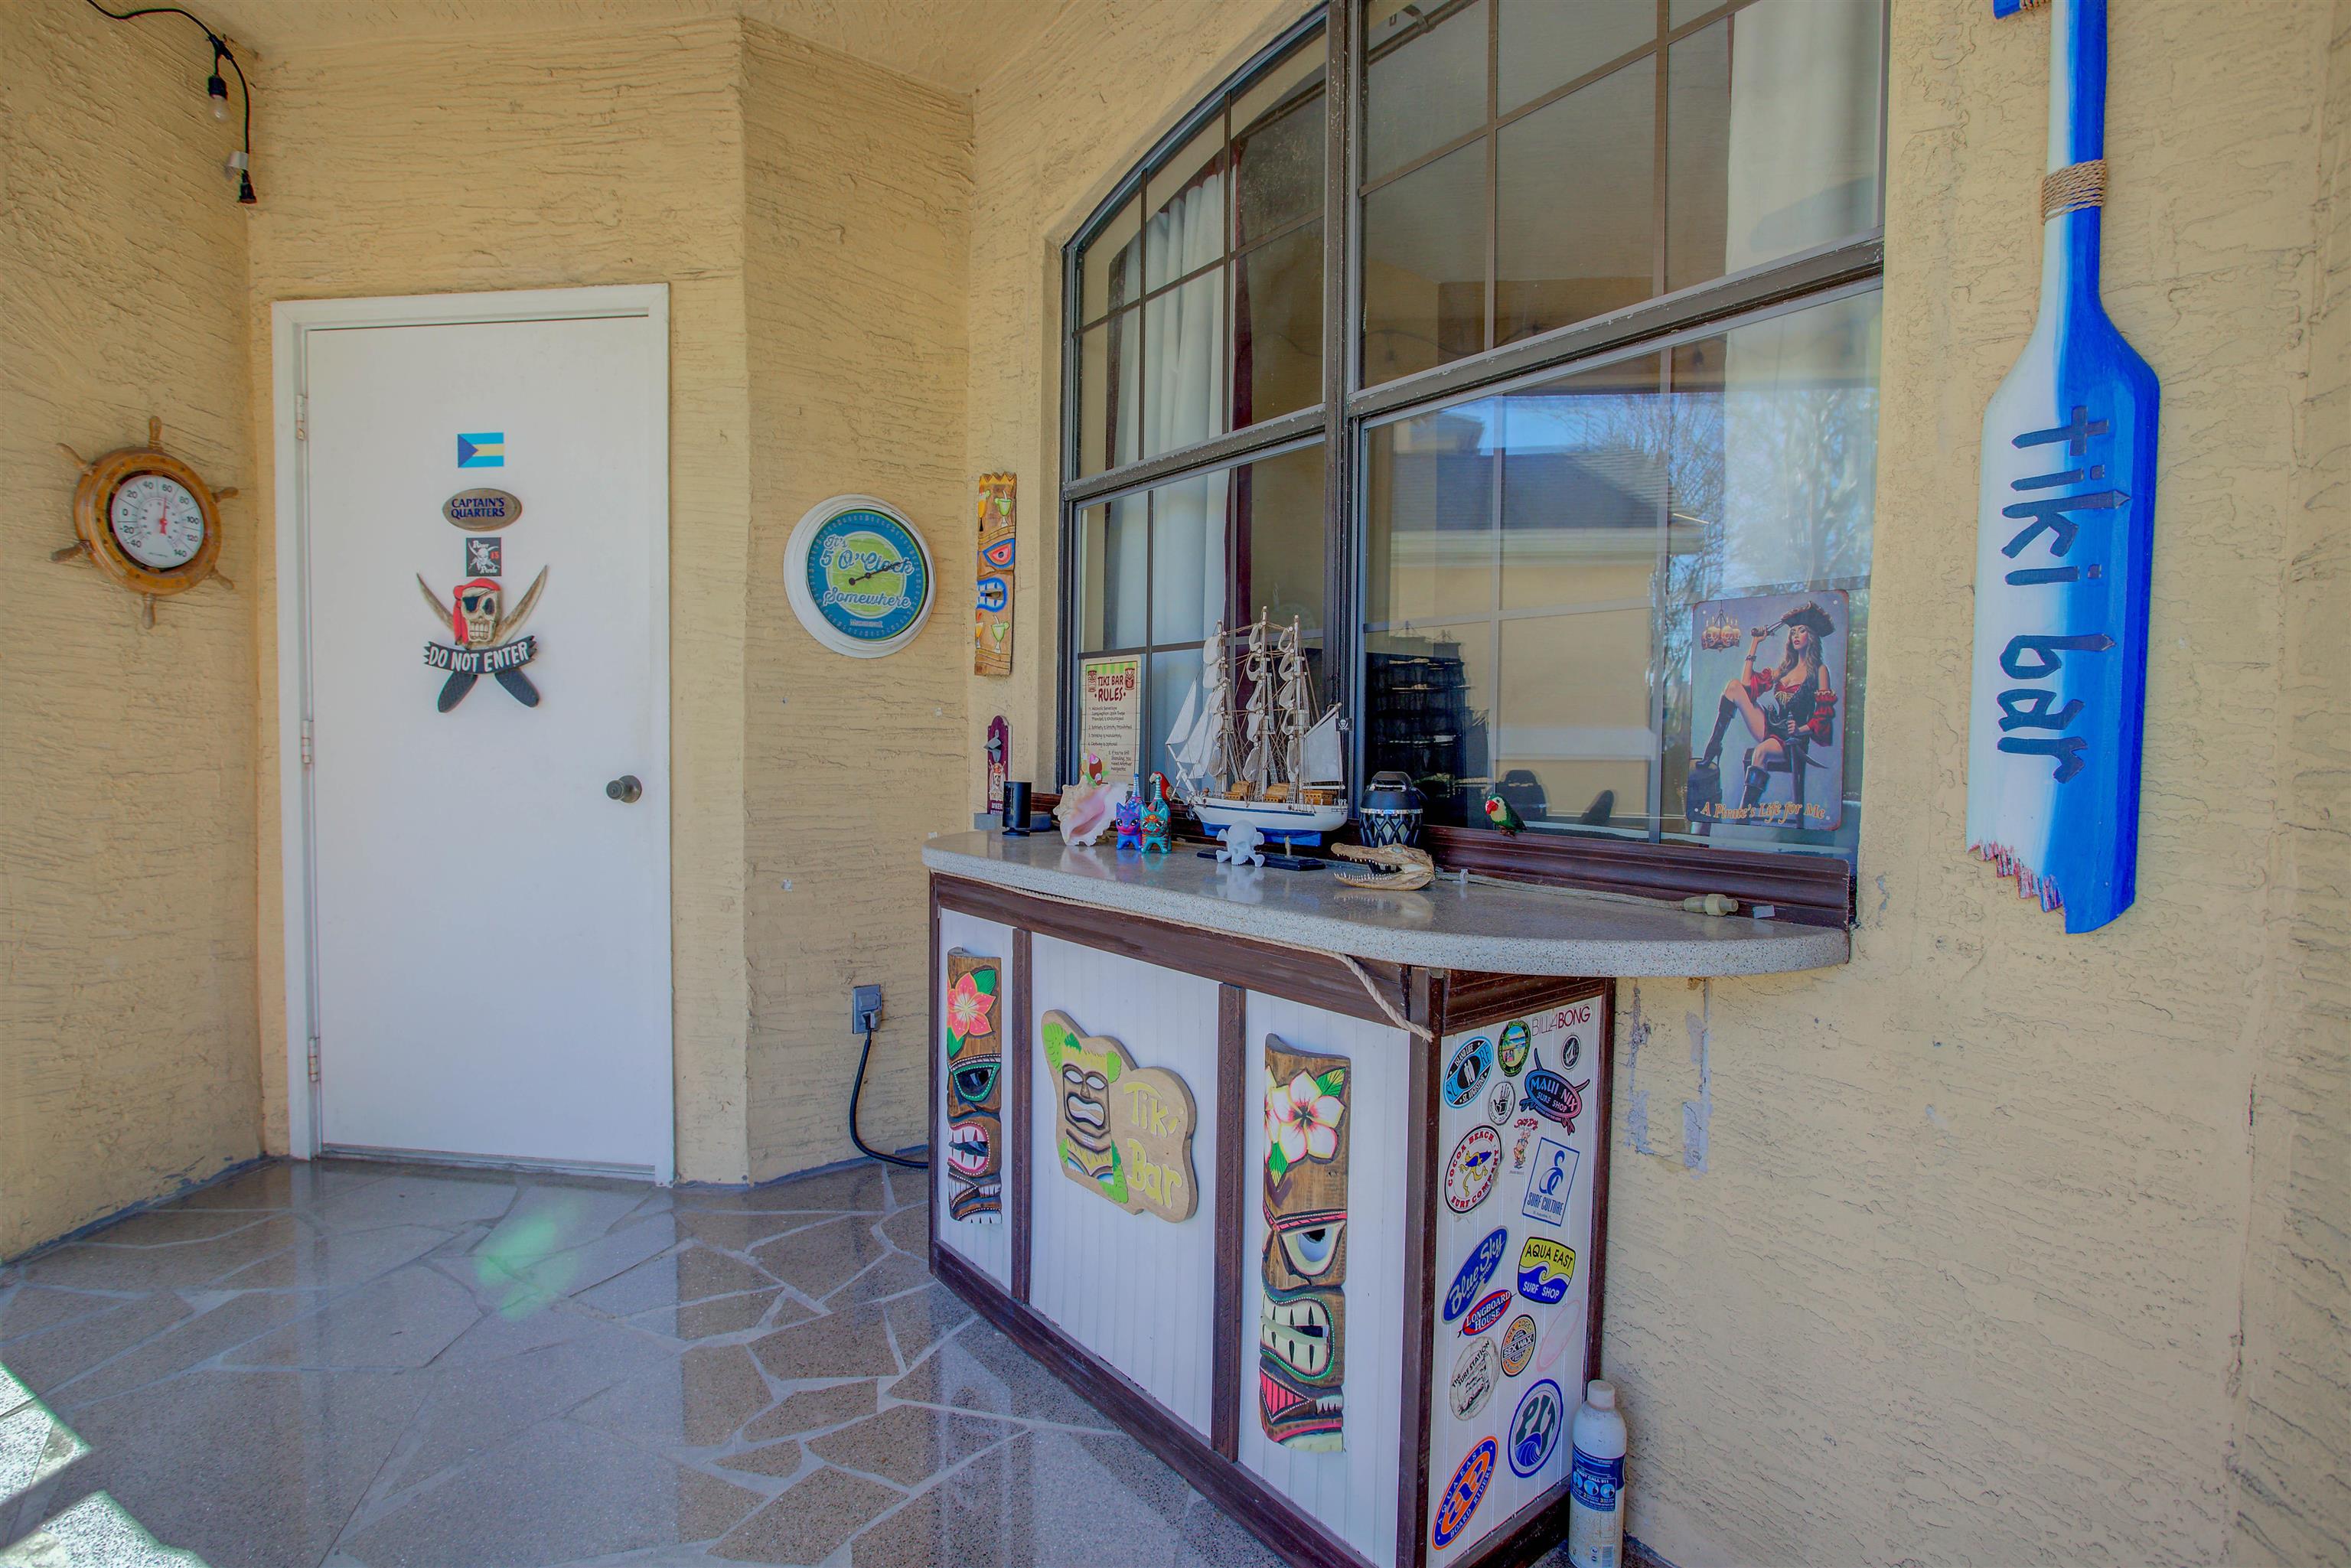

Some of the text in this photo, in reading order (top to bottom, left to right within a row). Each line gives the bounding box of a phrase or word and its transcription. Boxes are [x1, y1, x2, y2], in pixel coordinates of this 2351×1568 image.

[127, 490, 137, 499] 20
[161, 484, 172, 493] 60
[451, 507, 505, 520] QUARTERS
[452, 497, 505, 508] CAPTAIN'S
[174, 549, 187, 557] 140
[824, 535, 848, 549] It's
[820, 549, 834, 566] 5
[824, 585, 911, 608] Somewhere
[1997, 405, 2132, 784] tiki bar
[429, 641, 530, 673] DO NOT ENTER
[1097, 674, 1123, 687] TIKI BAR
[1097, 686, 1123, 703] RULES
[1700, 800, 1825, 825] A Pirate's Life for Me
[1531, 1006, 1591, 1037] BILLABONG
[1531, 1077, 1577, 1111] MAUI NIX
[1537, 1091, 1567, 1113] SURF SHOP
[1124, 1083, 1185, 1138] Tiki
[1448, 1130, 1495, 1187] COCOA BEACH
[1127, 1139, 1183, 1209] Bar
[1451, 1195, 1470, 1208] SURF
[1527, 1191, 1542, 1208] SURF
[1541, 1197, 1564, 1216] CULTURE
[1524, 1244, 1573, 1270] AQUA EAST
[1449, 1234, 1506, 1315] Blue Sky
[1522, 1280, 1560, 1299] SURF SHOP
[1466, 1290, 1511, 1327] LONGBOARD
[1474, 1307, 1501, 1331] HOUSE
[1503, 1344, 1517, 1358] SEX
[1517, 1335, 1532, 1350] WAX
[1457, 1369, 1471, 1387] SURF
[1469, 1340, 1490, 1371] STATION
[1438, 1445, 1484, 1525] AQUA EAST
[1449, 1465, 1492, 1538] BOARD RIDERS
